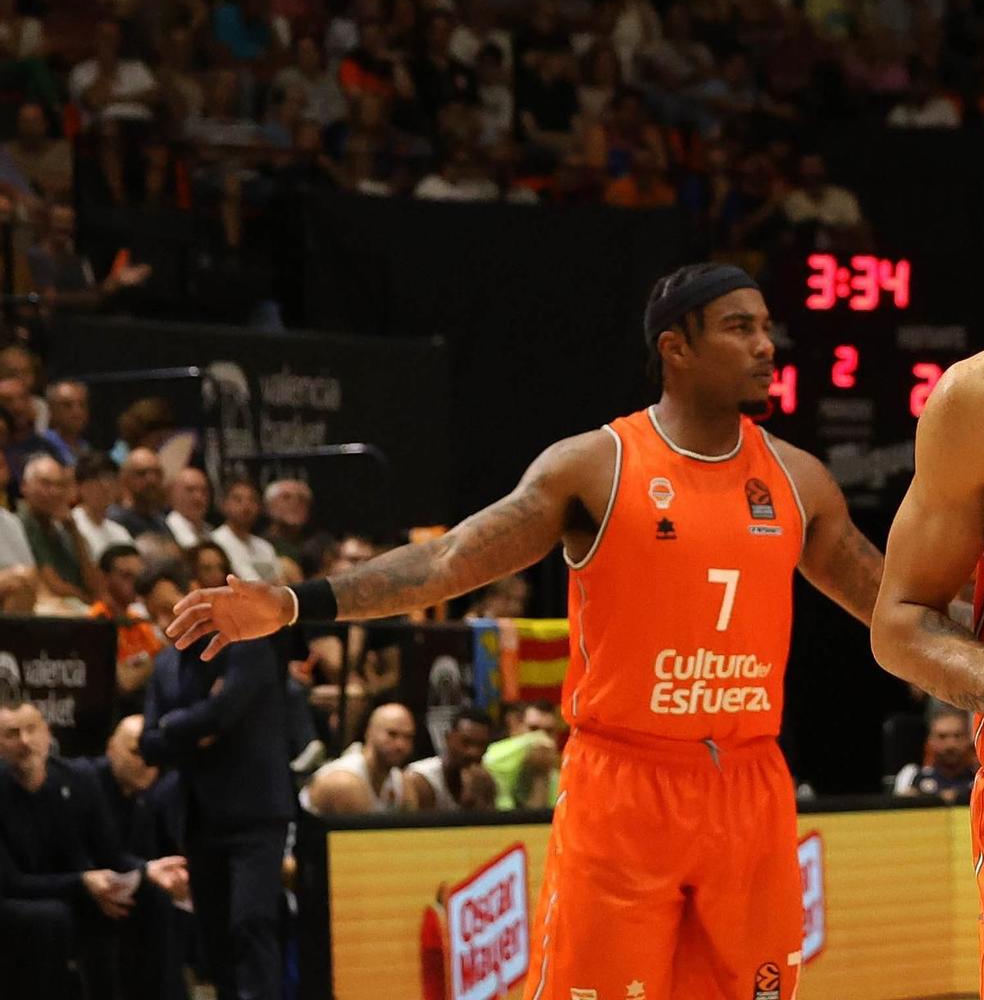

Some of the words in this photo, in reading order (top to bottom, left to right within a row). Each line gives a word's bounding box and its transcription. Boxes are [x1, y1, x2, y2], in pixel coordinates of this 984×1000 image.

[805, 253, 912, 312] 3:34
[830, 344, 860, 390] 2
[708, 568, 740, 632] 7
[654, 648, 757, 680] Cultura
[462, 872, 515, 942] Oscar
